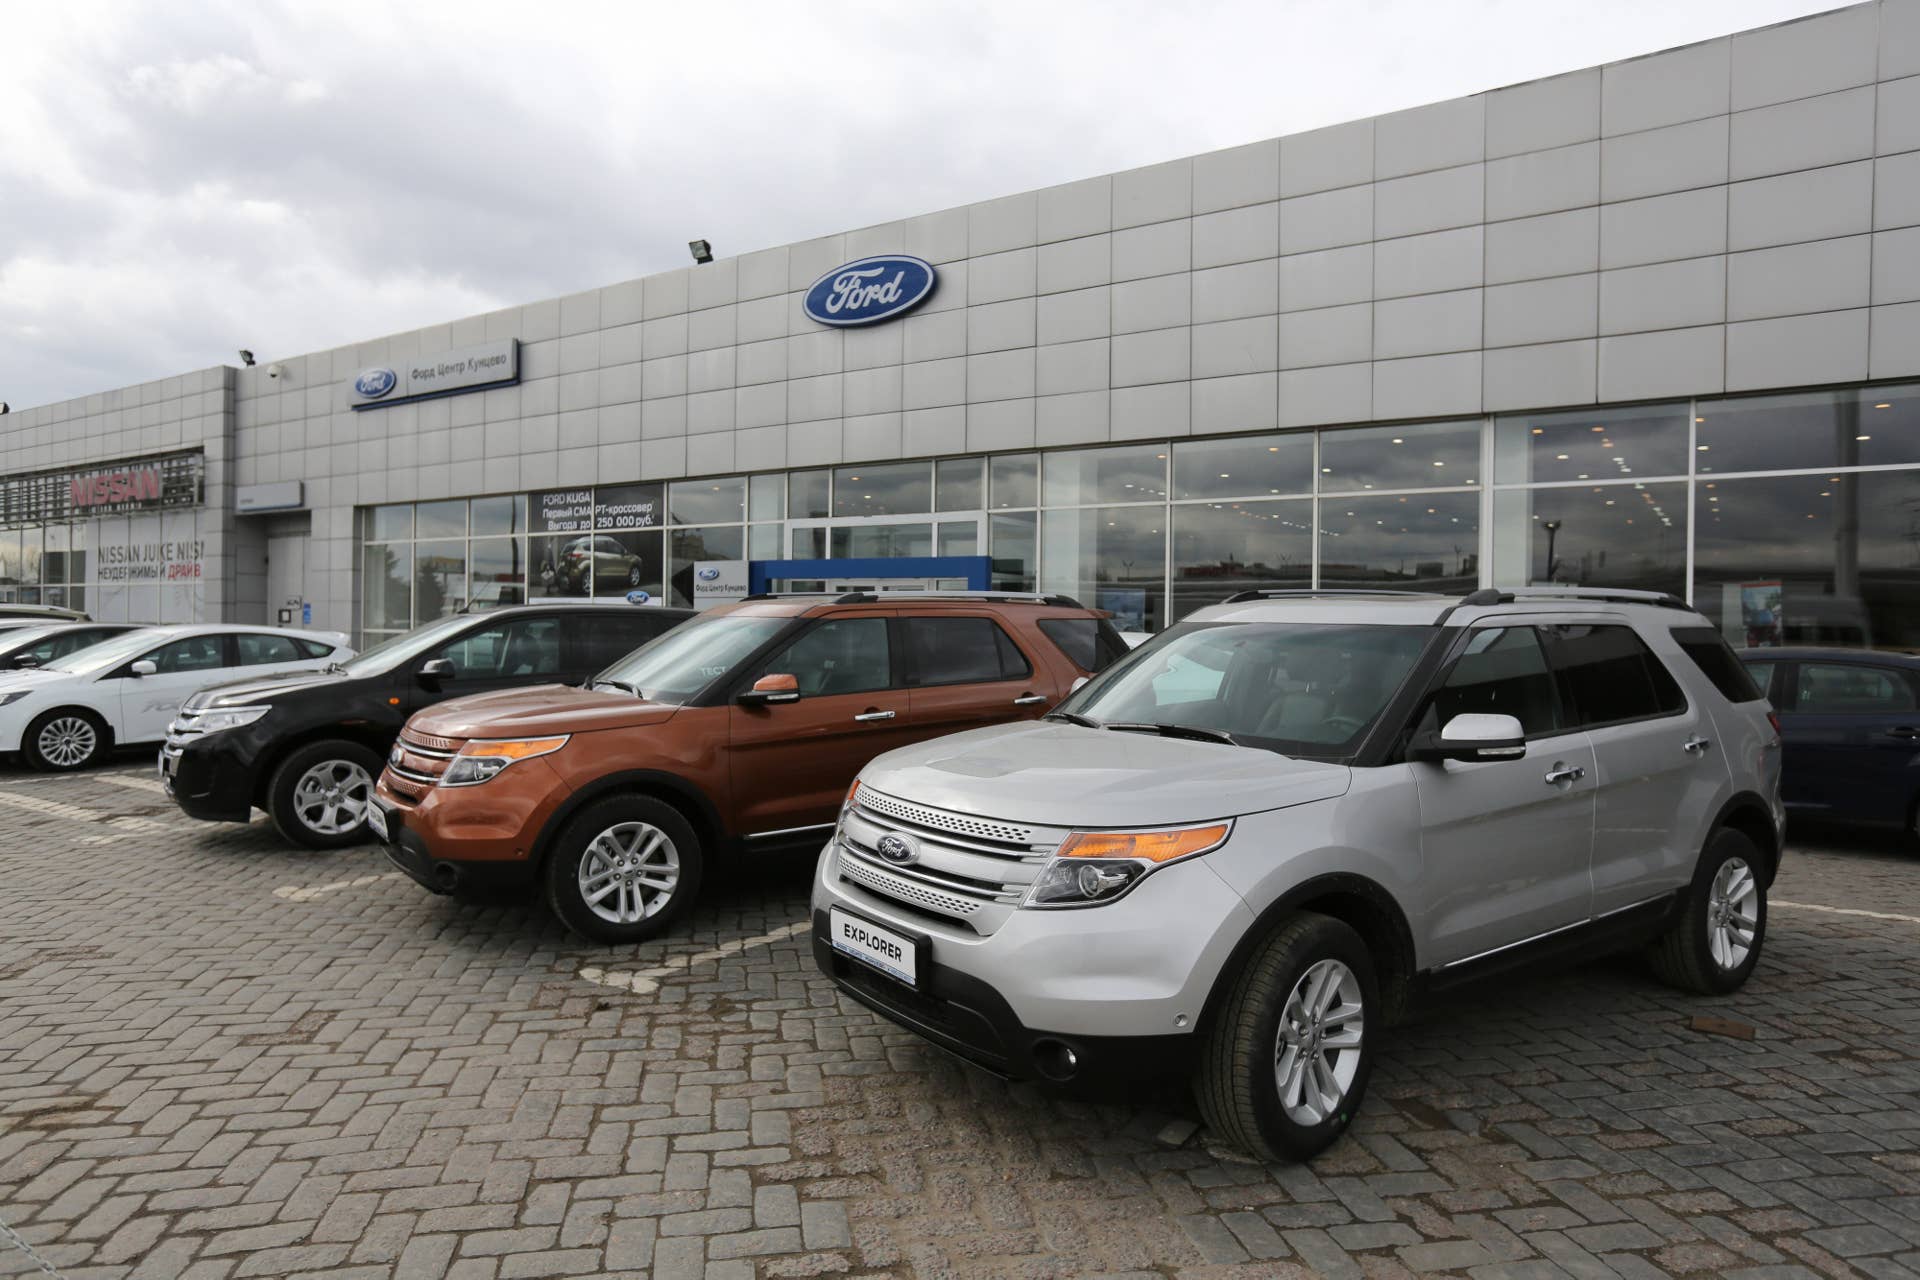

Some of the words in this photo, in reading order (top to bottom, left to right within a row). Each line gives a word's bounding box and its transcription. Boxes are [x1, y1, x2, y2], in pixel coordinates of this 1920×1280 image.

[825, 266, 905, 314] Ford
[411, 369, 436, 381] Форд
[437, 362, 466, 378] Центр
[467, 353, 508, 373] Кунцево
[71, 468, 160, 508] NISSAN
[543, 493, 566, 506] FORD
[566, 491, 591, 504] KUGA
[542, 506, 573, 519] Первый
[547, 520, 578, 531] Выгода
[580, 520, 591, 530] до
[597, 517, 614, 528] 250
[616, 515, 635, 527] 000
[98, 544, 140, 564] NISSAN
[143, 543, 174, 563] JUKE
[167, 561, 201, 580] ДРАЙВ
[882, 837, 905, 858] Ford
[843, 922, 903, 963] EXPLORER
